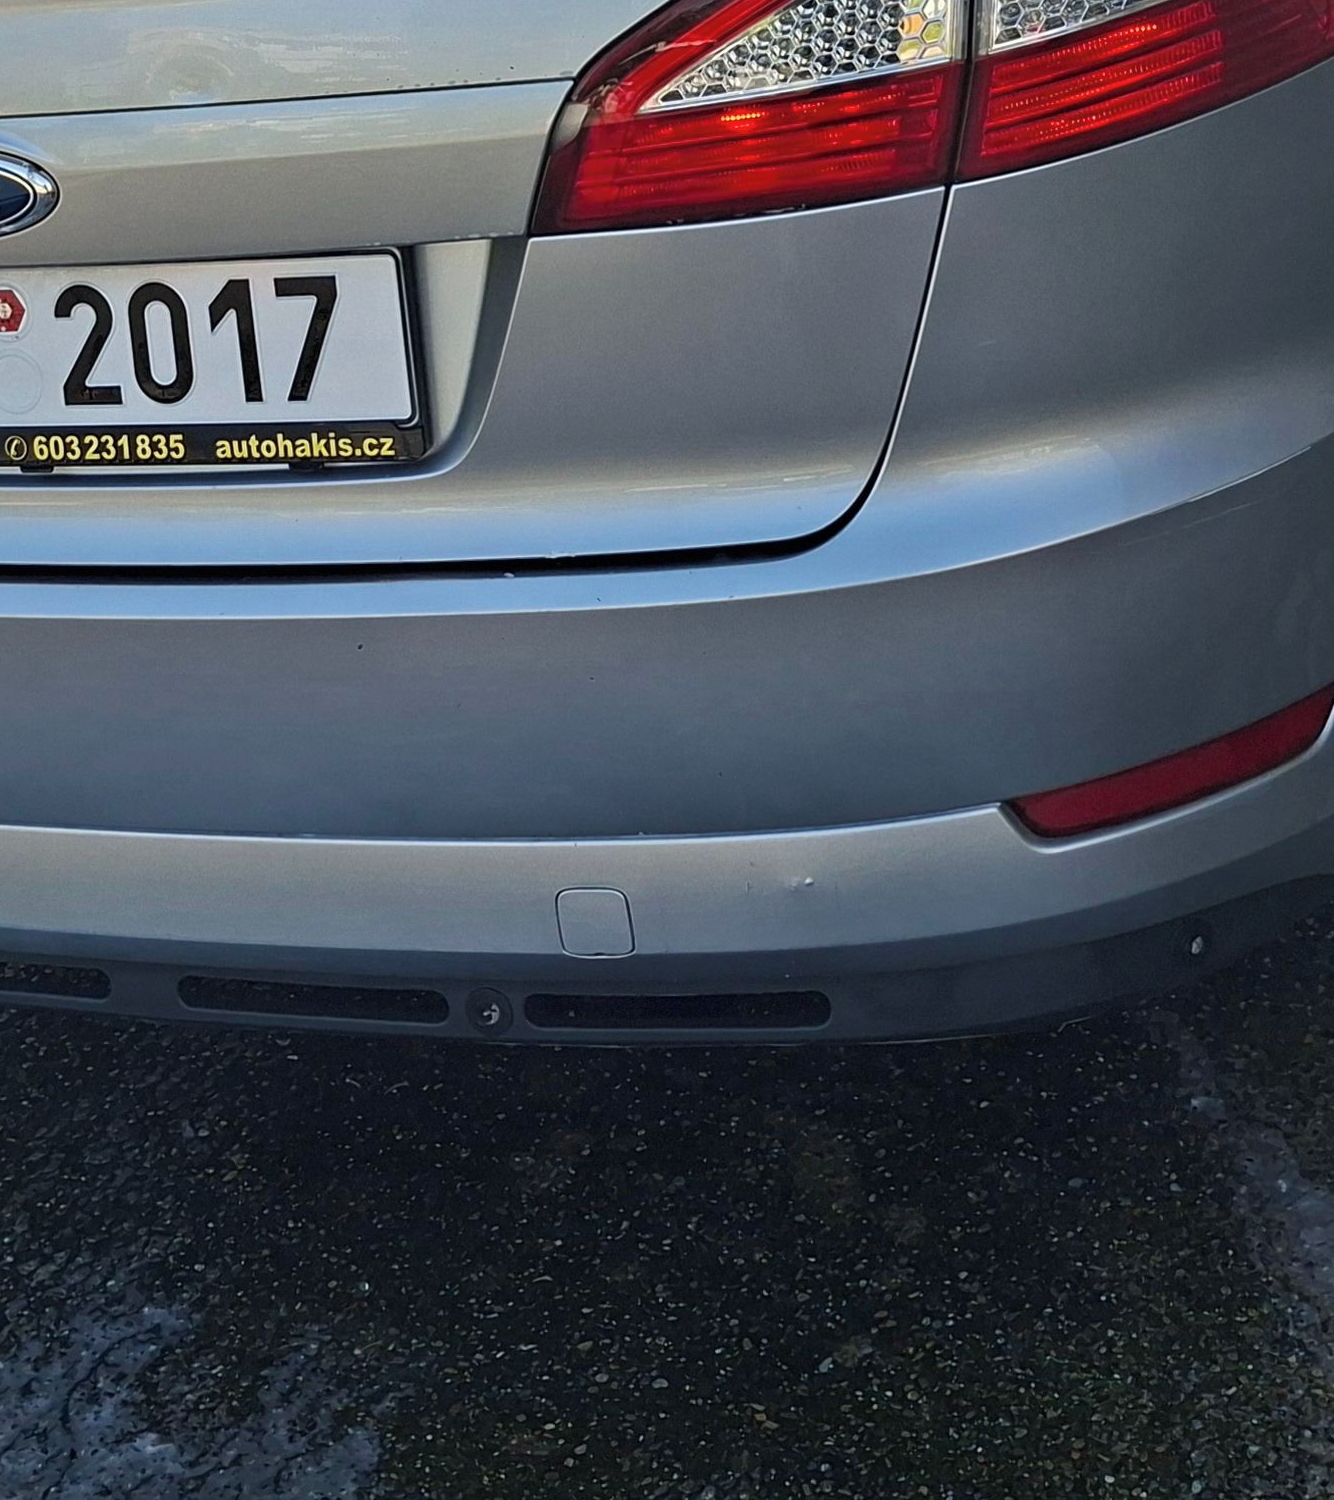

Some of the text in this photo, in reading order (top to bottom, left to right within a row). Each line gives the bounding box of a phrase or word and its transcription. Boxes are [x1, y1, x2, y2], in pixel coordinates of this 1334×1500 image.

[53, 274, 338, 407] 2017
[33, 434, 185, 460] 603231835
[216, 433, 396, 459] autohakis.cz
